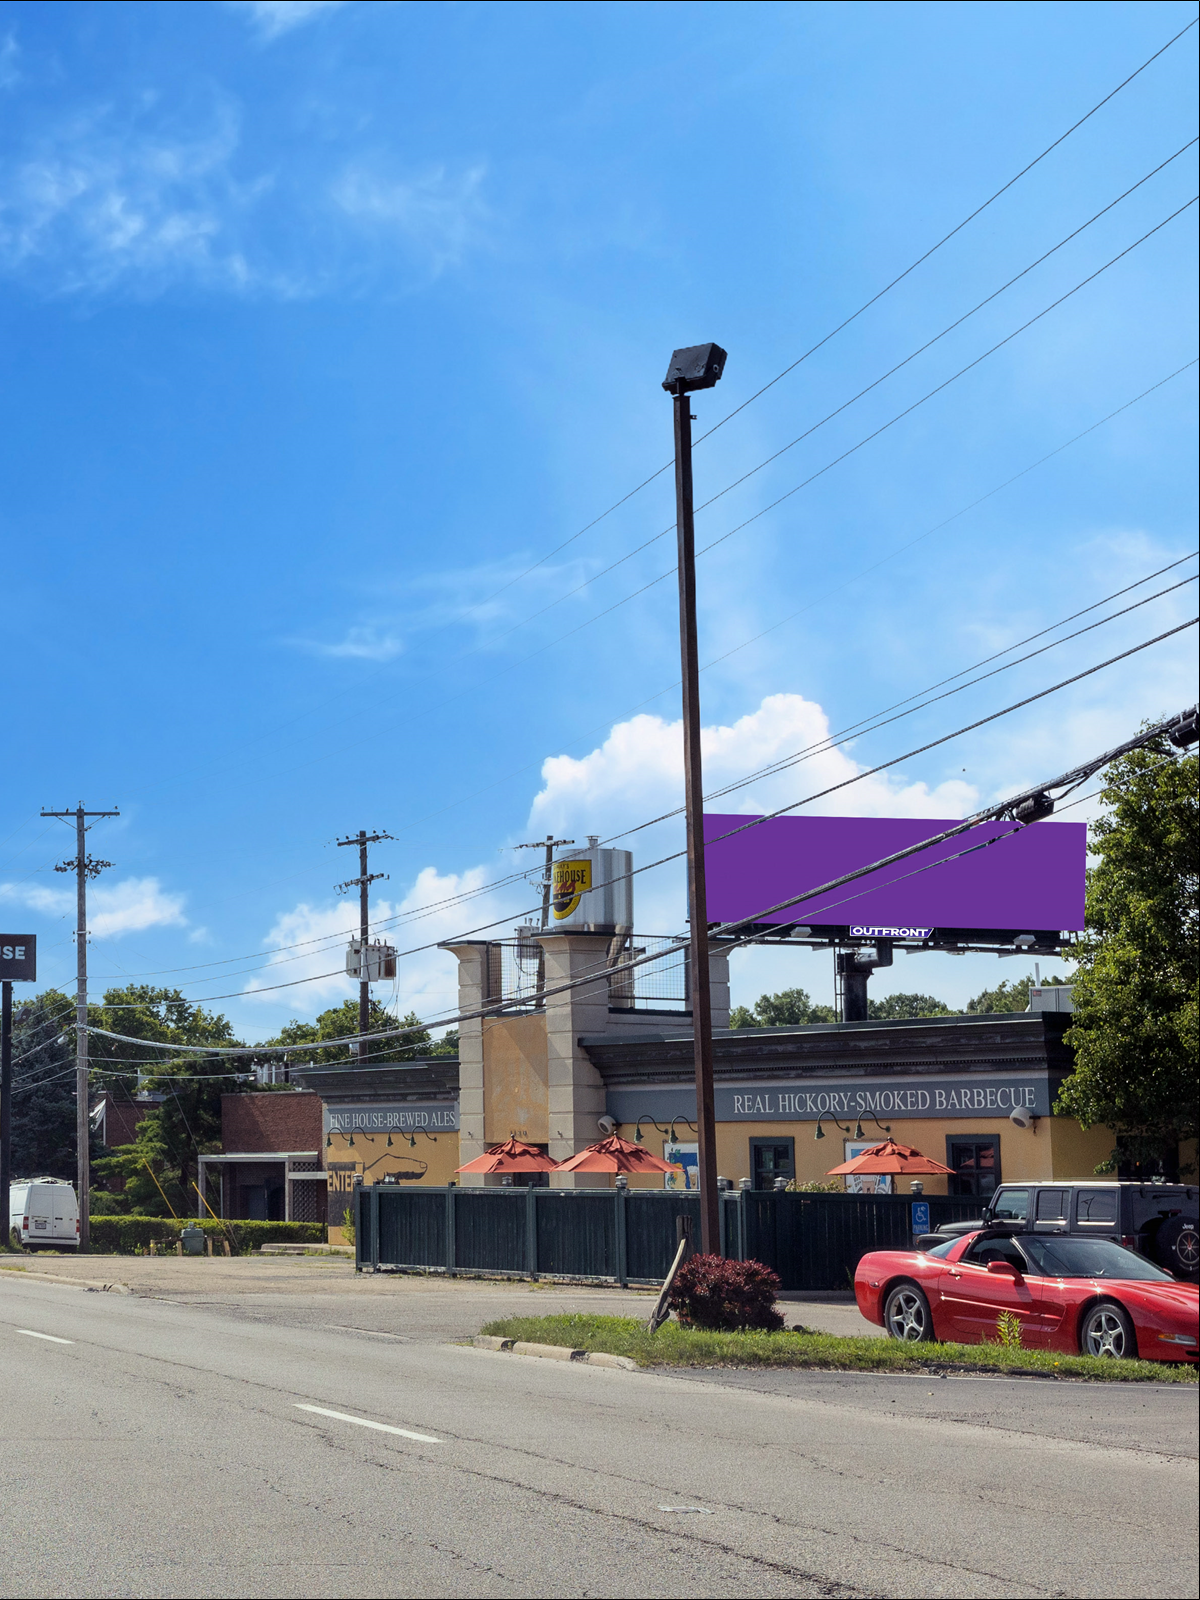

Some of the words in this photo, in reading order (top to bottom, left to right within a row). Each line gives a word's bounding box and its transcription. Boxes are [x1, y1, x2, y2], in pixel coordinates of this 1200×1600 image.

[852, 927, 928, 937] OUTFRONT
[733, 1094, 774, 1113] REAL
[778, 1090, 931, 1113] HICKORY-SMOKED
[934, 1087, 1037, 1110] BARBECUE
[330, 1113, 350, 1128] FINE
[352, 1111, 429, 1127] HOUSE-BREWED
[430, 1111, 456, 1126] ALES
